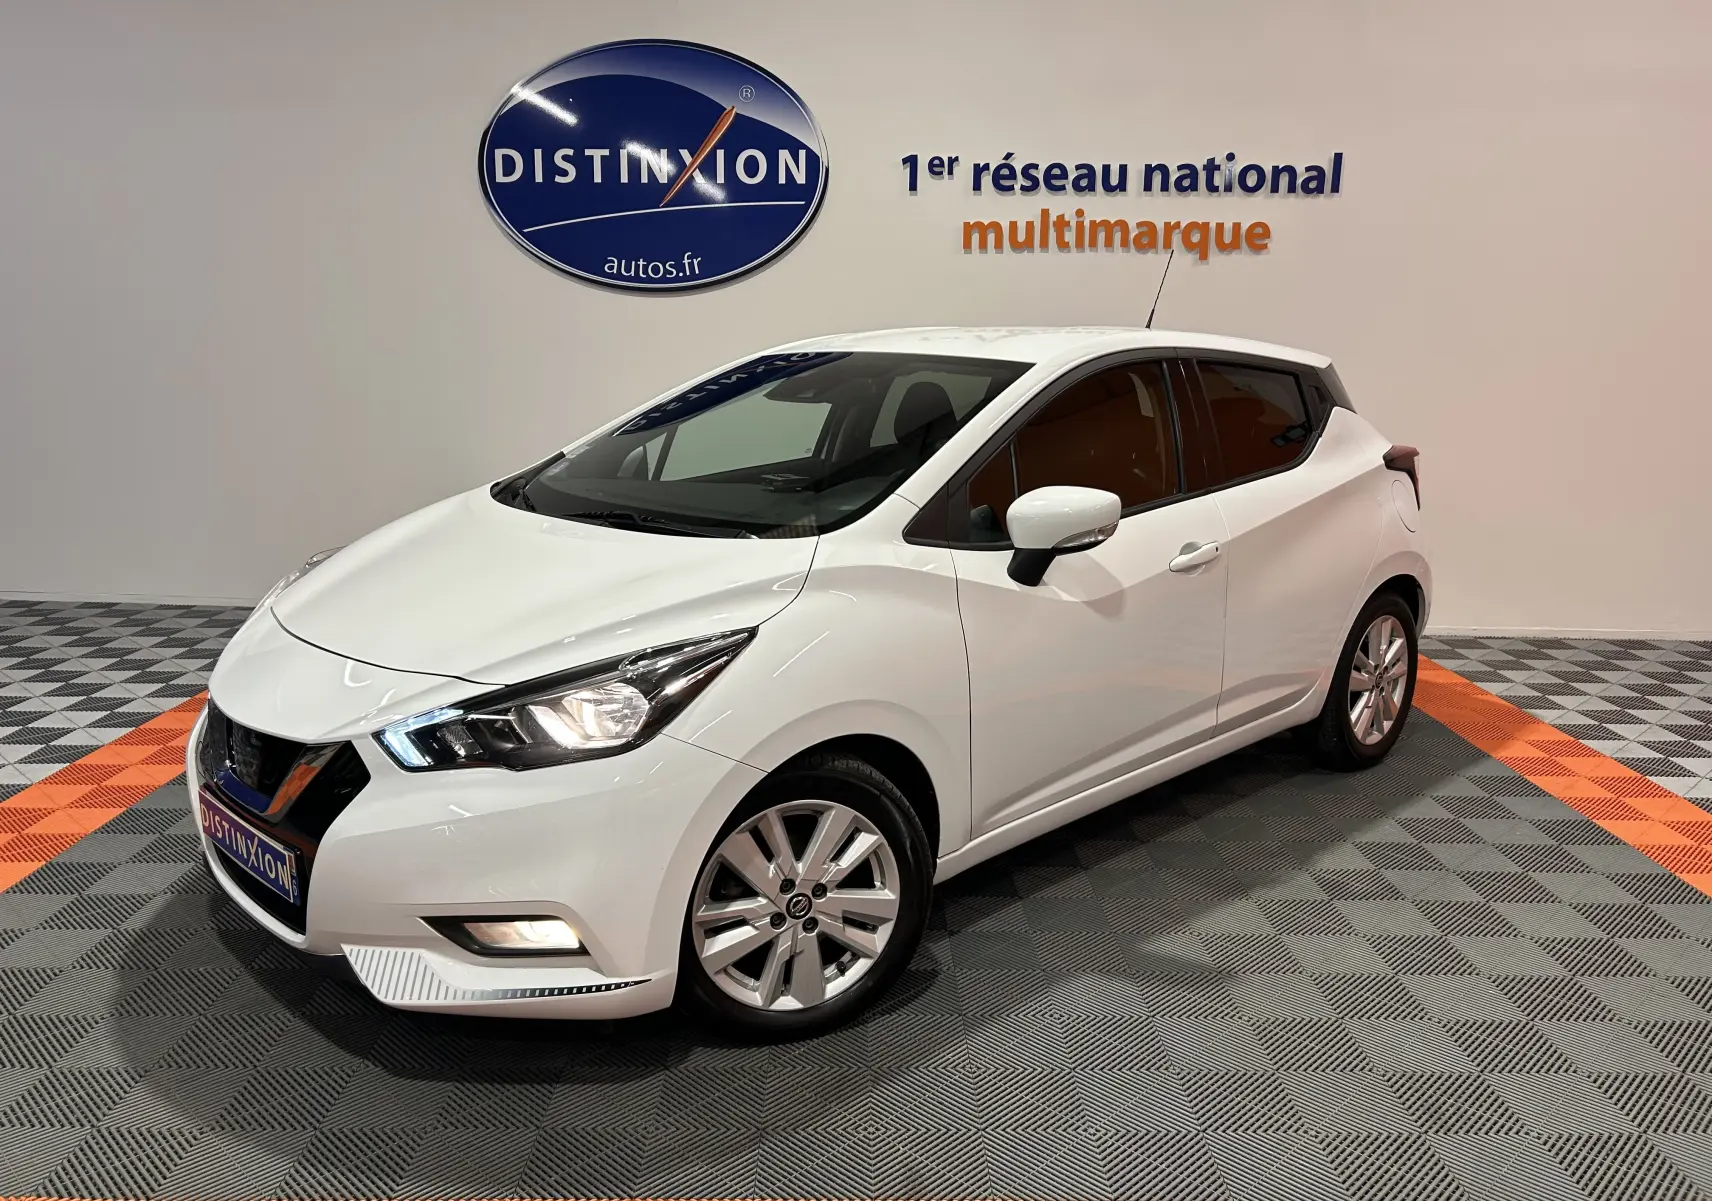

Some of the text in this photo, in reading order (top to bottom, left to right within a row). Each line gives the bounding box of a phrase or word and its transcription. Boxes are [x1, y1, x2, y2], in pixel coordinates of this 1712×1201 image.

[494, 148, 807, 184] DISTINXION
[901, 152, 1343, 195] 1er réseau national
[962, 208, 1271, 261] multimarque
[604, 252, 702, 279] autos.fr
[200, 803, 289, 890] DISTINXION
